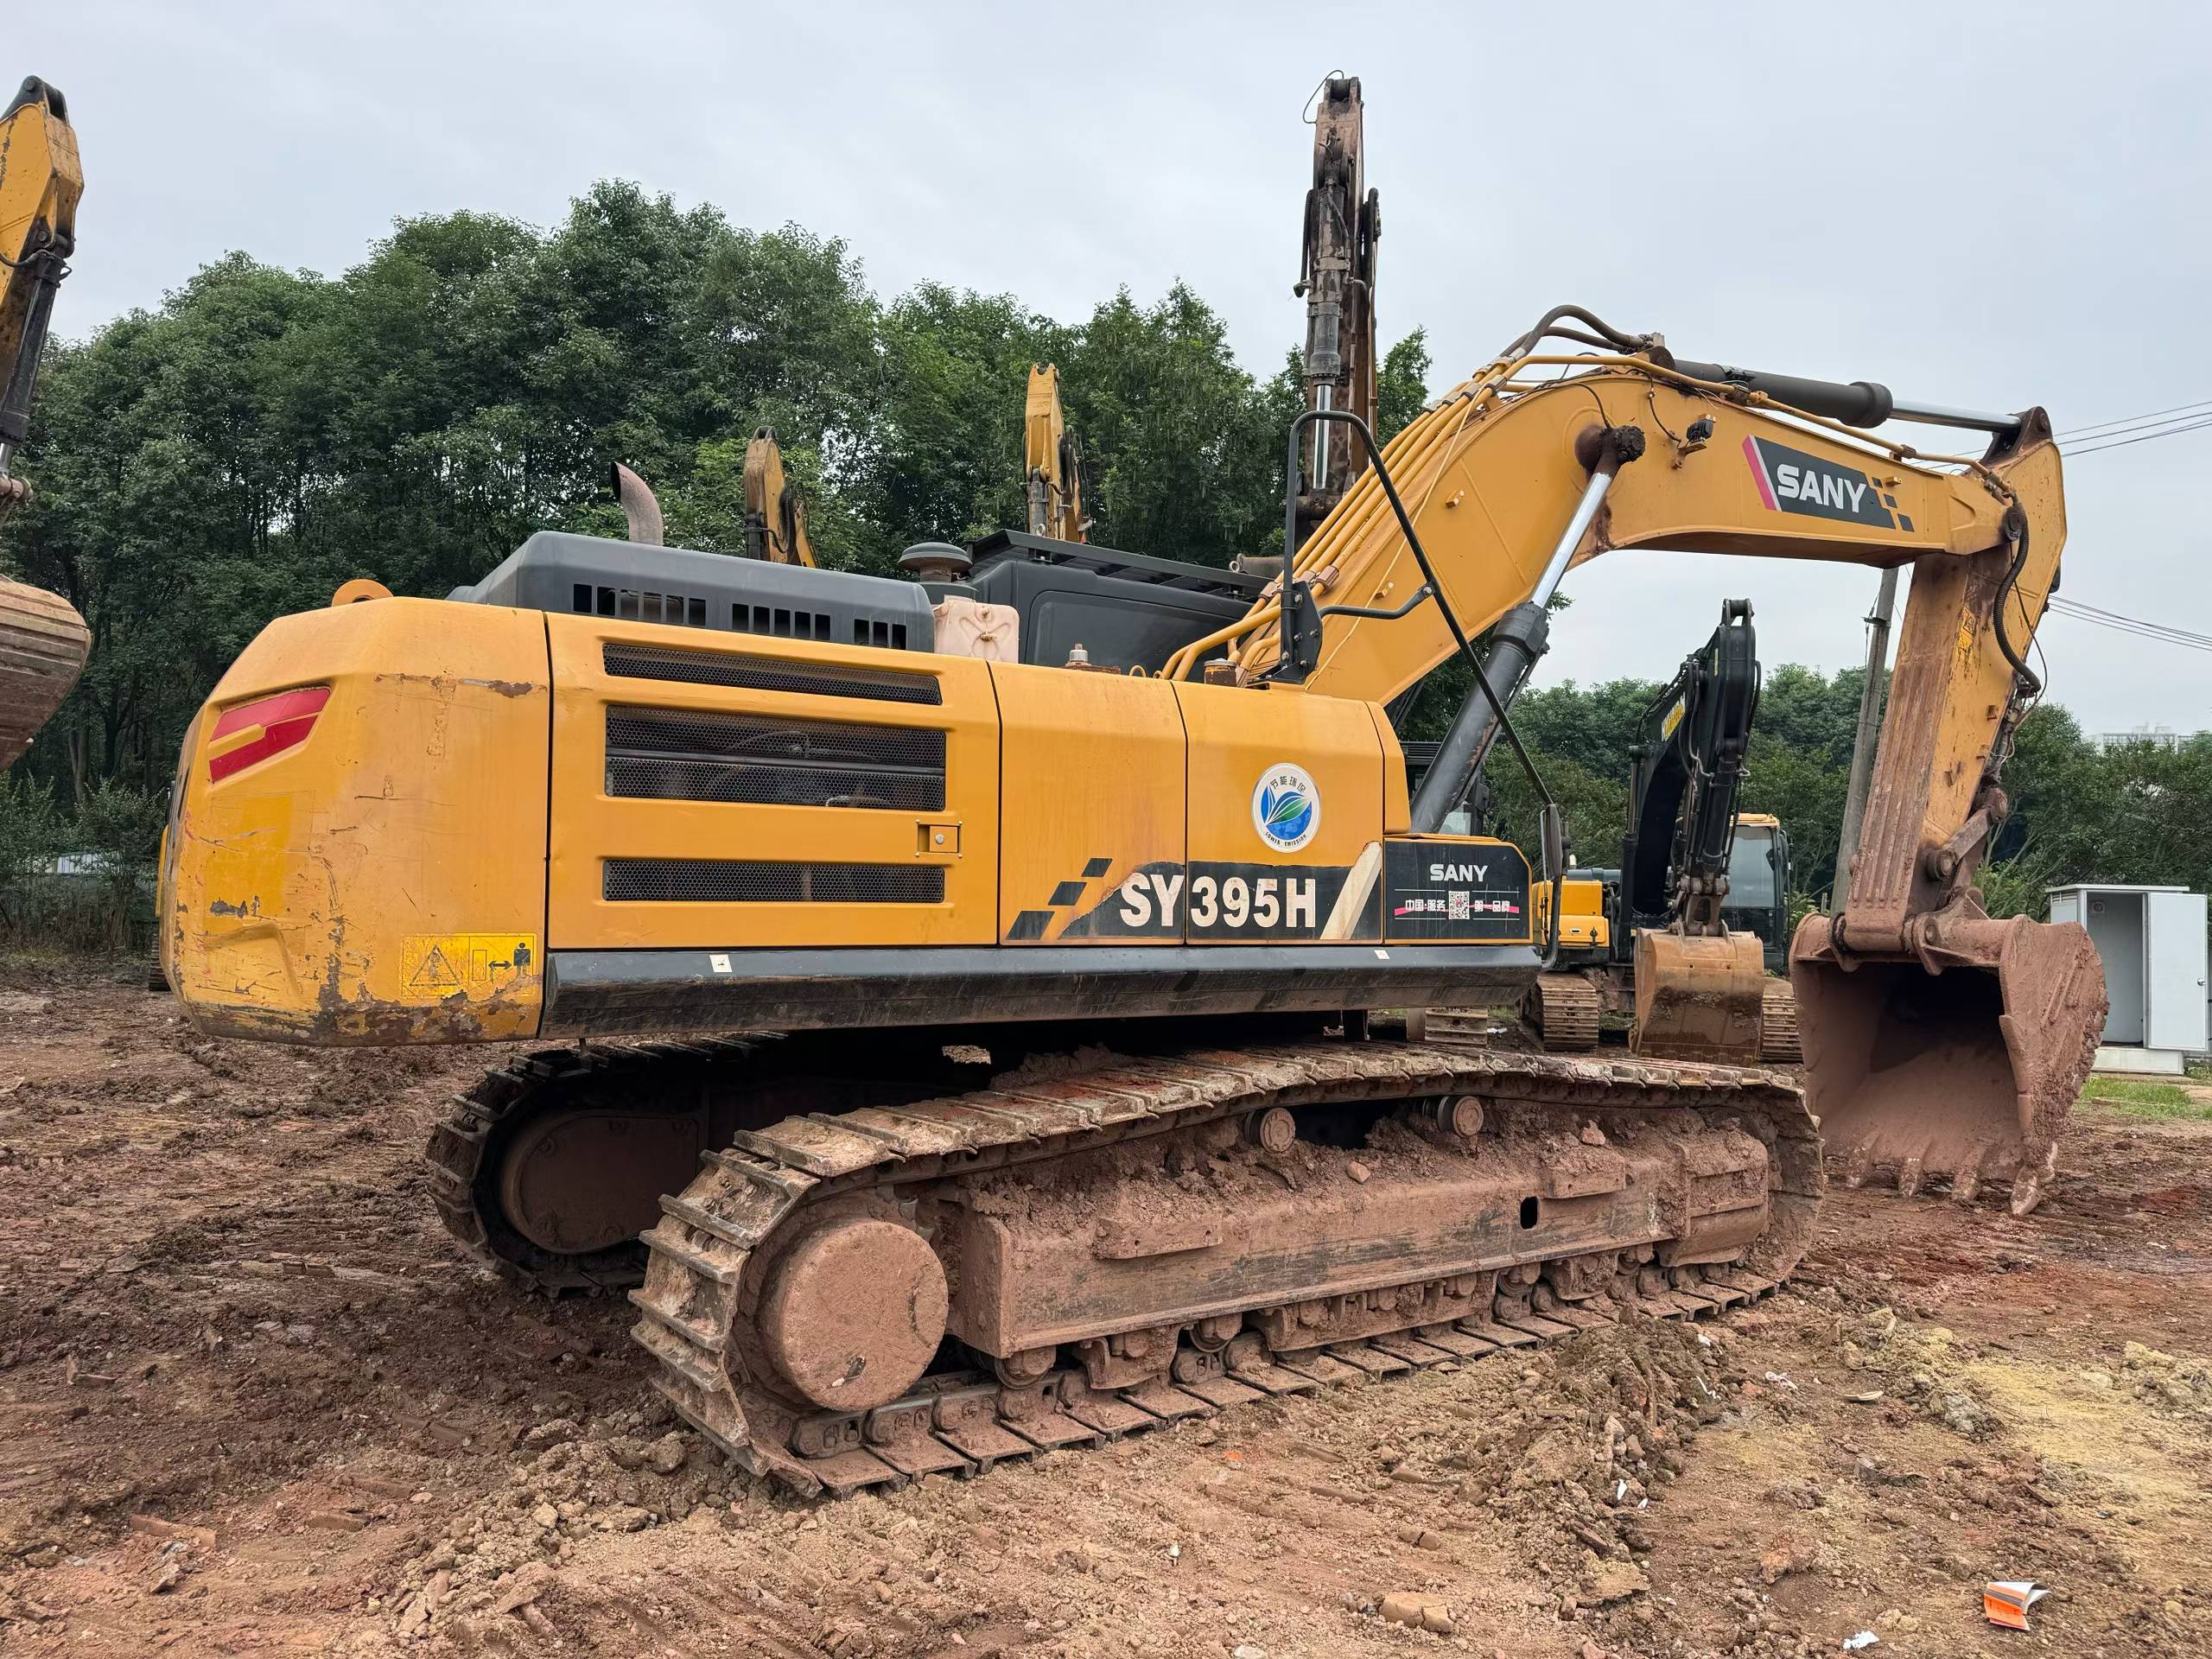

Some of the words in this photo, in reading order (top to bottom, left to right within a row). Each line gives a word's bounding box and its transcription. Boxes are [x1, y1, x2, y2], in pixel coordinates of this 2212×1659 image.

[1777, 463, 1867, 513] SANY
[1269, 776, 1306, 793] 节能环保
[1284, 834, 1307, 847] EMISSION
[1429, 863, 1489, 882] SANY
[1119, 872, 1316, 929] SY395H
